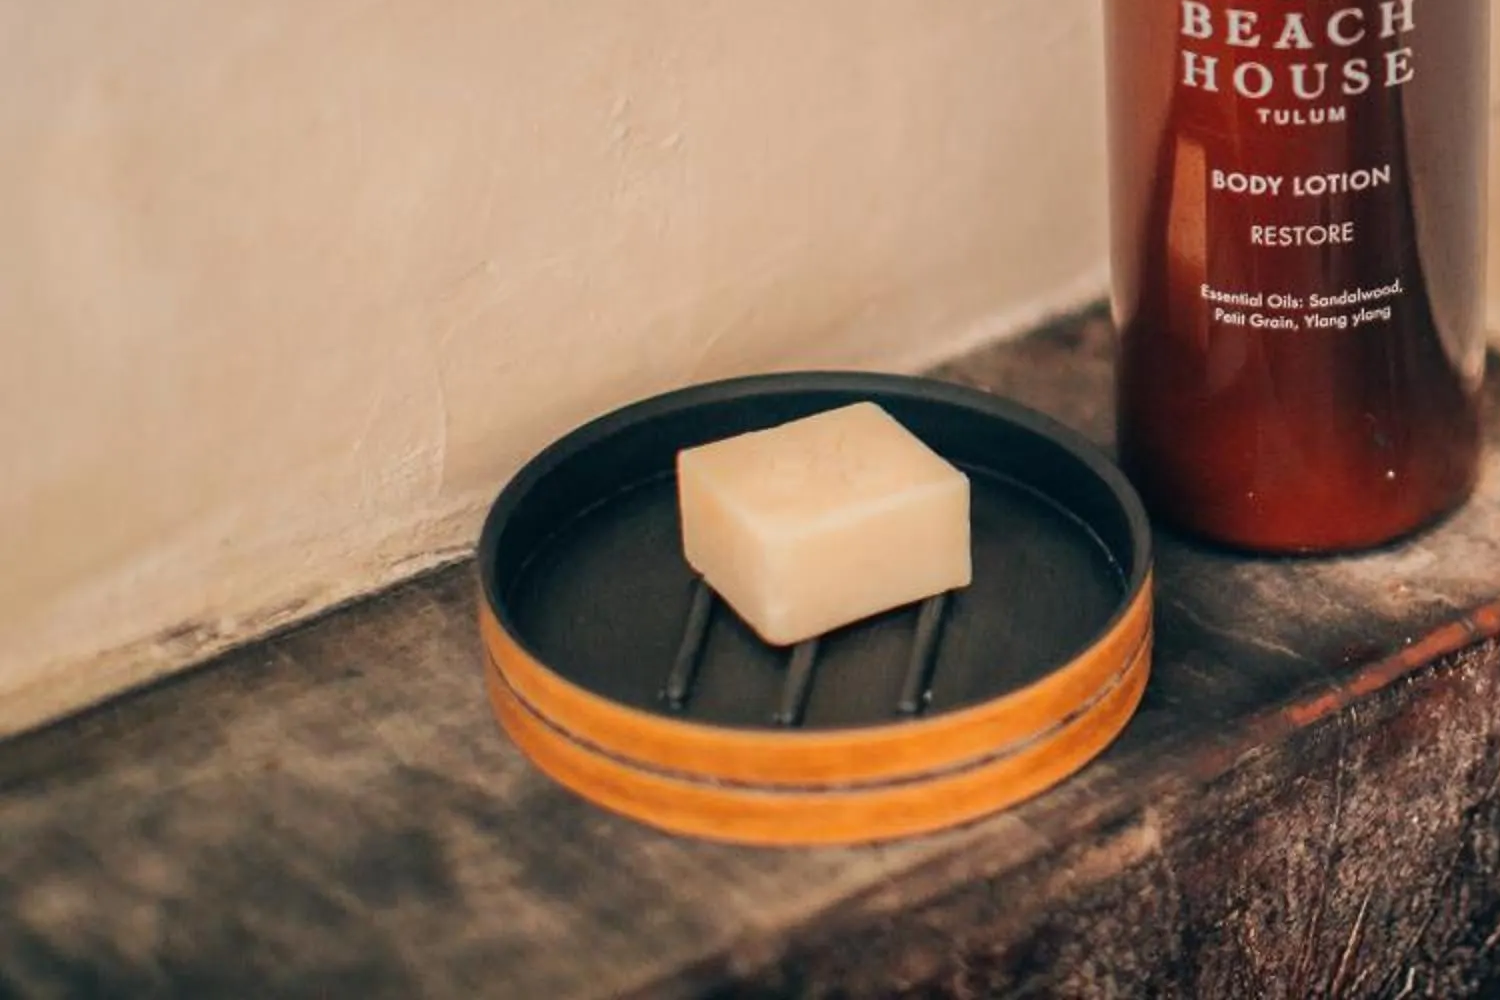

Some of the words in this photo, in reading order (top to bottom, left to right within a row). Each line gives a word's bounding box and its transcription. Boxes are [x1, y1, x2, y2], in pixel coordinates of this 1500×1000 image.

[1181, 47, 1415, 99] HOUSE
[1256, 106, 1347, 125] TULUM
[1211, 169, 1283, 196] BODY
[1292, 164, 1391, 196] LOTION
[1250, 221, 1354, 246] RESTORE
[1200, 283, 1263, 307] Essential
[1267, 293, 1303, 309] Oils:
[1309, 279, 1403, 308] Sandalwood,
[1214, 308, 1245, 326] Petit
[1249, 312, 1299, 331] Grain,
[1303, 312, 1347, 329] Ylang
[1352, 305, 1391, 327] ylang
